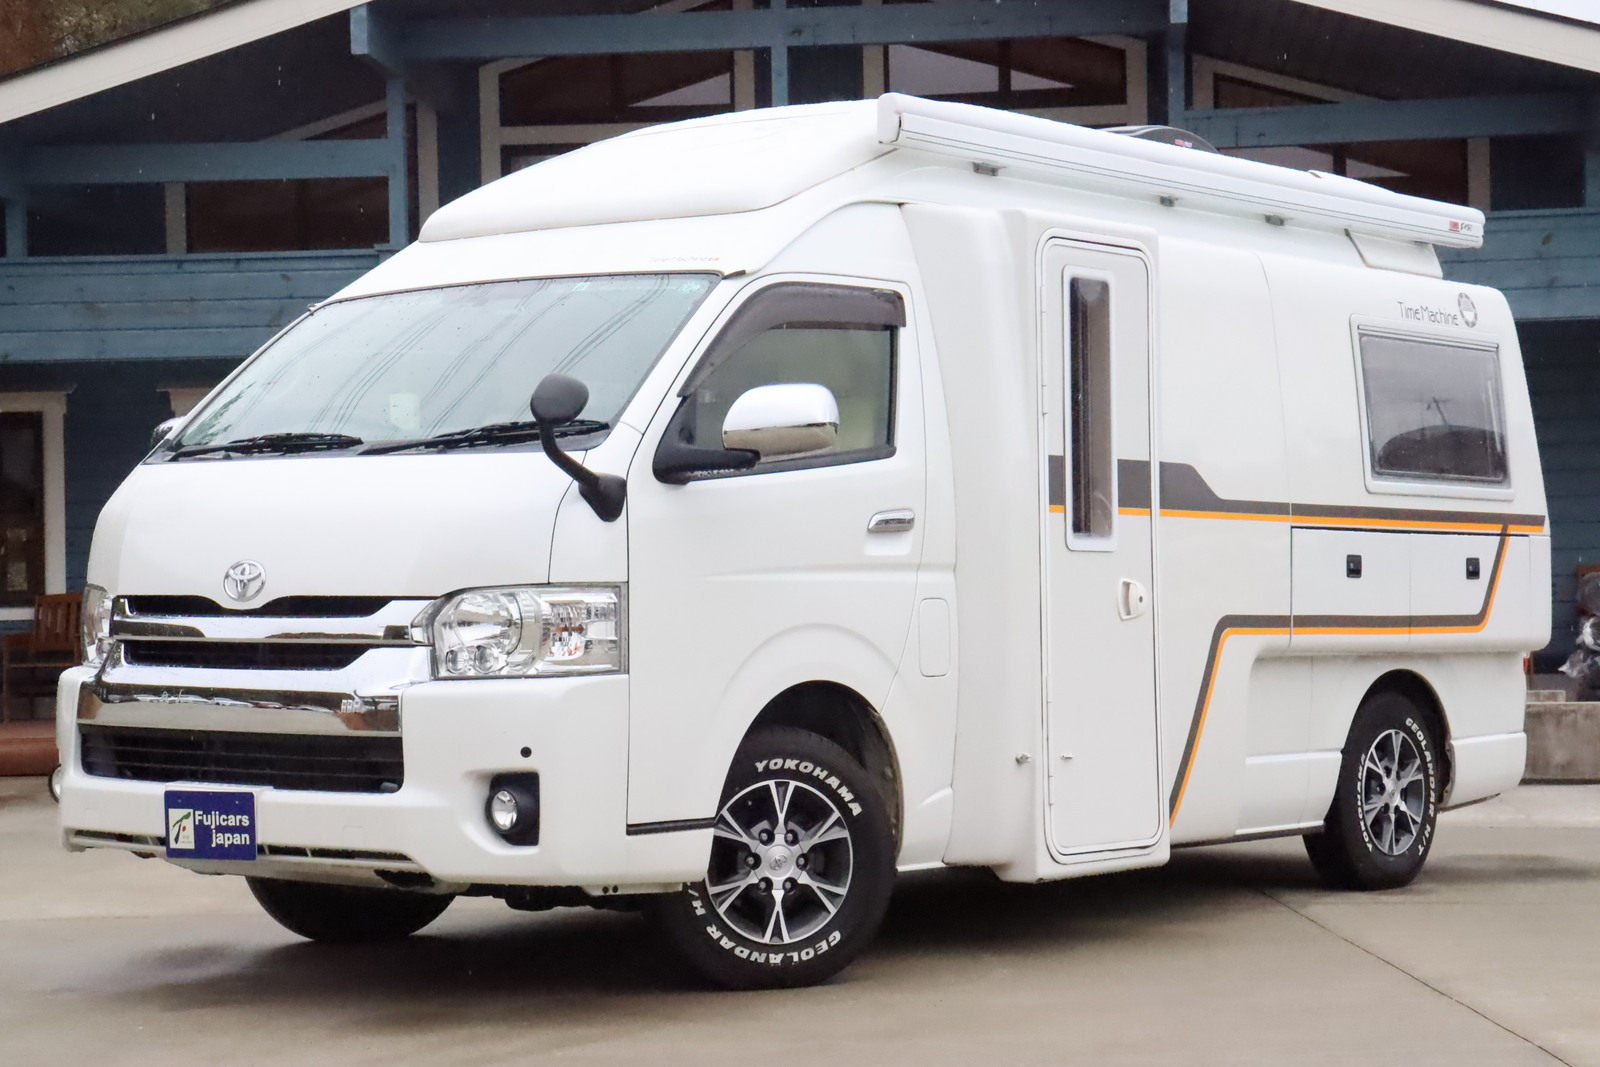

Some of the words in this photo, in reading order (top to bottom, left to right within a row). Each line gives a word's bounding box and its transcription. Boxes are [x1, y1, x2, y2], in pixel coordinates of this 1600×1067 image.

[1405, 717, 1436, 818] GEOLANDAR
[754, 758, 863, 817] YOKOHAMA
[194, 810, 250, 829] Fujicars
[211, 829, 250, 848] japan
[687, 882, 706, 916] H/
[706, 923, 842, 965] GEOLANDAR
